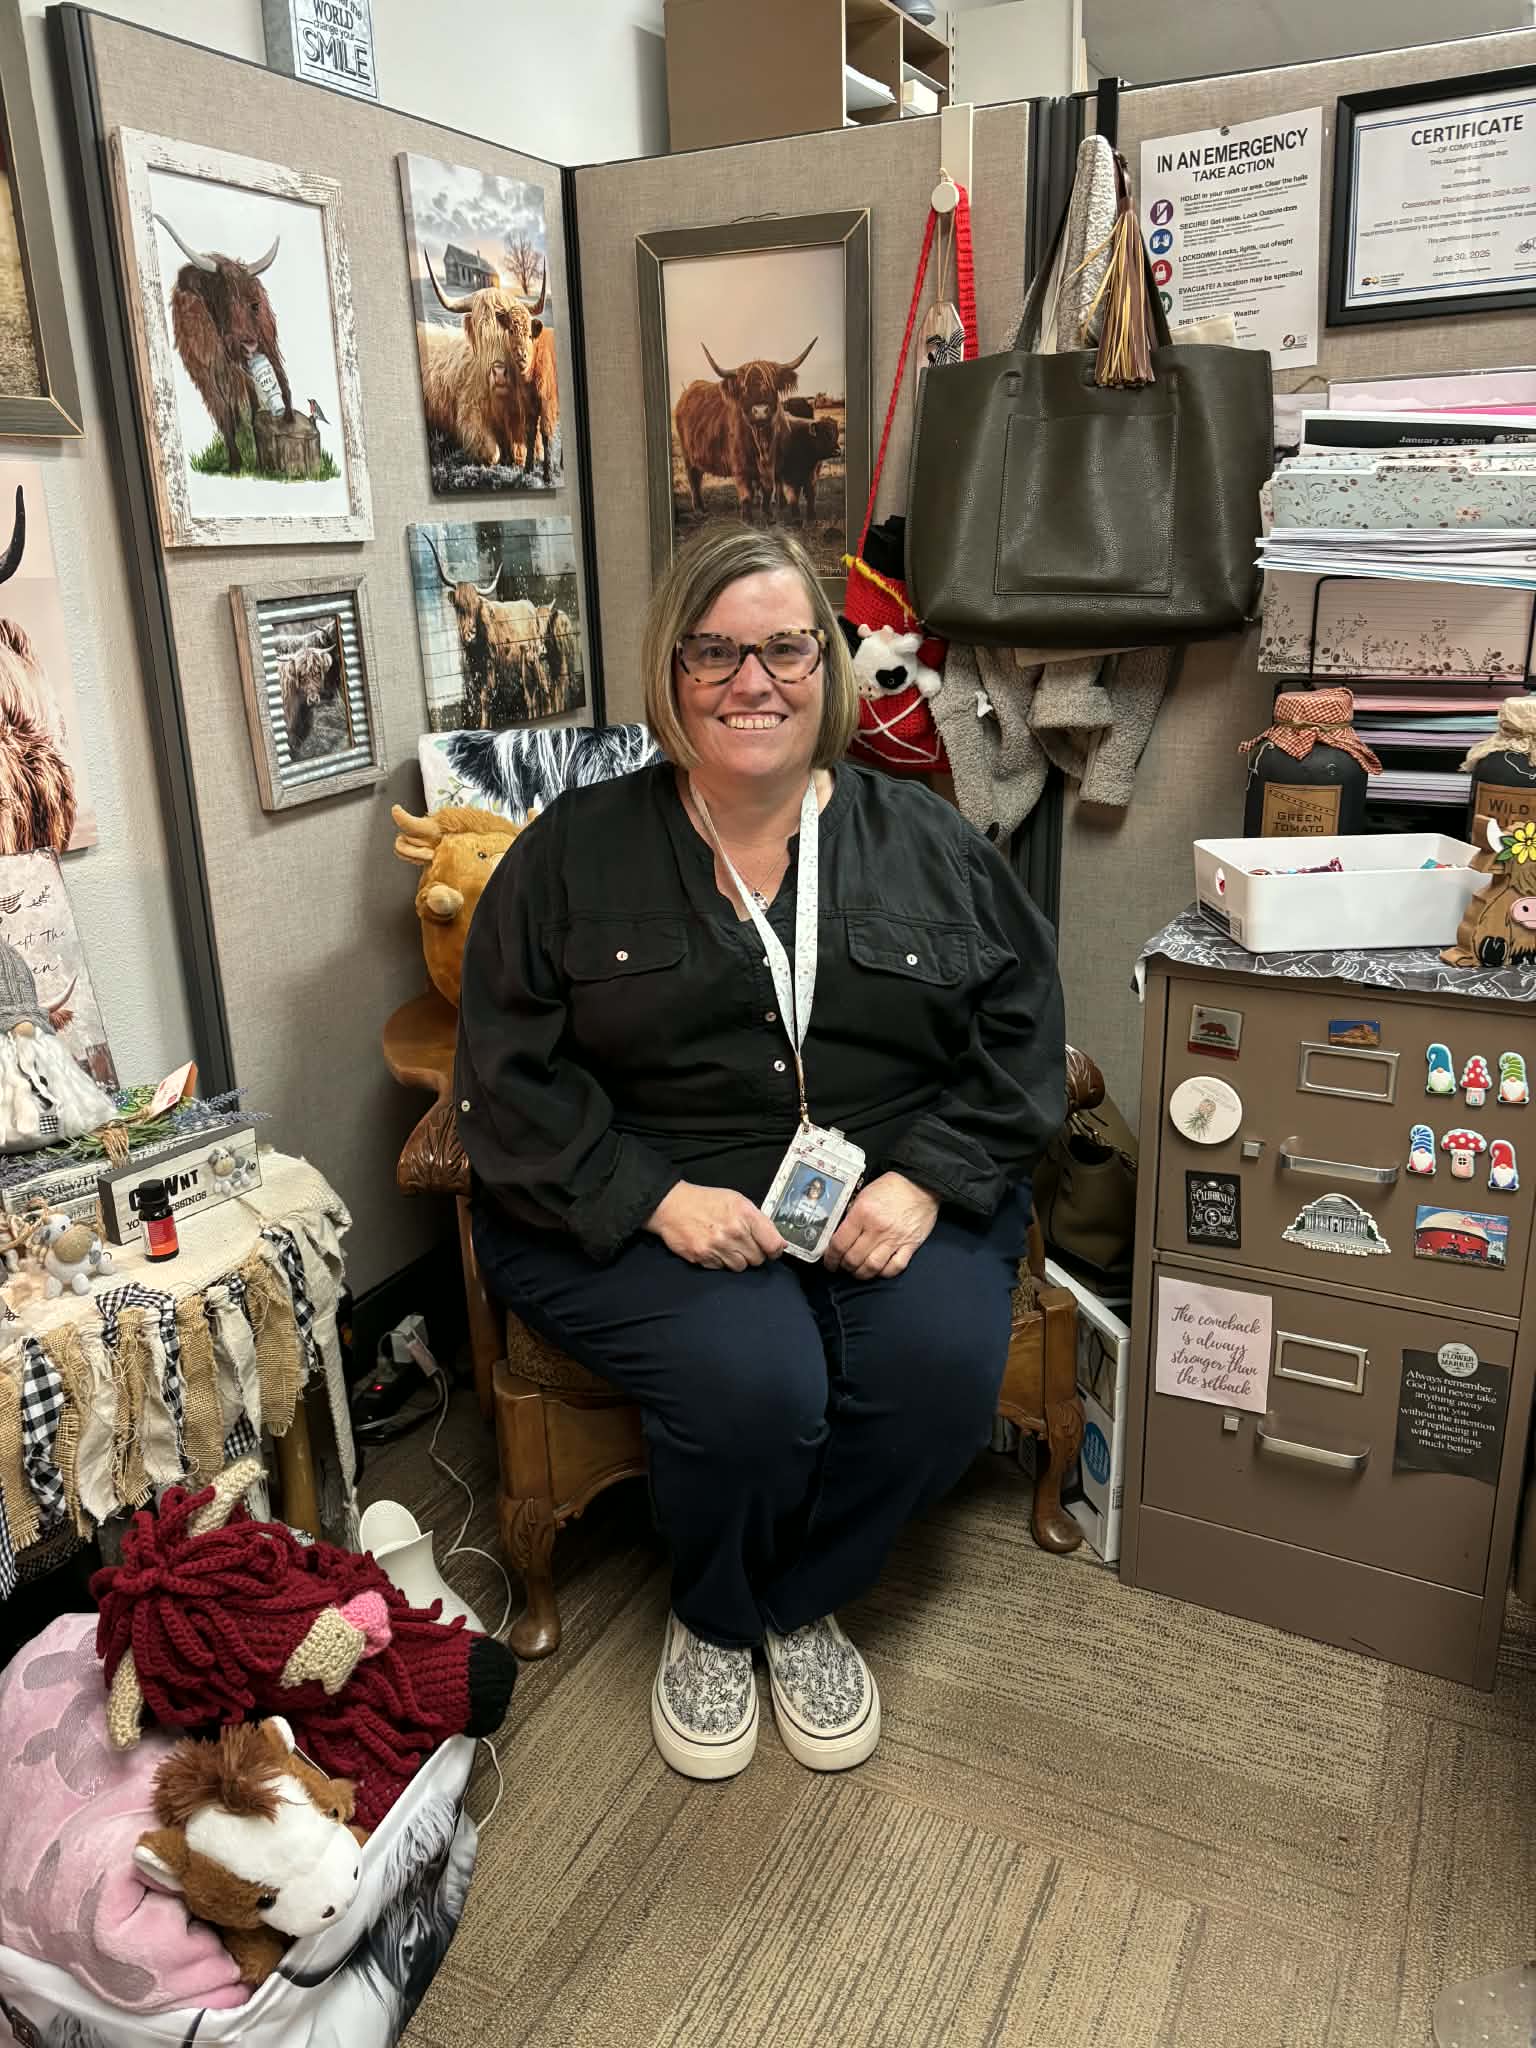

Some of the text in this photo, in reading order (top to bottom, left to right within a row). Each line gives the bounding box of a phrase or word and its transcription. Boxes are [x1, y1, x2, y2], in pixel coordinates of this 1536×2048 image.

[313, 0, 354, 30] WORLD
[313, 20, 355, 41] change your
[303, 27, 370, 80] SMILE
[1411, 114, 1524, 146] CERTIFICATE
[1156, 127, 1308, 173] IN AN EMERGENCY
[1438, 139, 1497, 154] OF COMPLETION
[1192, 157, 1275, 182] TAKE ACTION
[1209, 190, 1223, 200] your
[1264, 179, 1281, 188] Clear
[1282, 176, 1293, 185] the
[1210, 217, 1221, 225] Get
[1243, 211, 1258, 220] Lock
[1178, 250, 1218, 263] LOCKDOWN!
[1432, 254, 1453, 264] June
[1249, 276, 1263, 286] may
[1264, 273, 1273, 282] be
[1399, 436, 1440, 445] January
[1488, 798, 1529, 815] WILD
[1277, 811, 1322, 822] GREEN
[1272, 822, 1324, 833] TOMATO
[39, 927, 66, 945] The
[129, 1169, 199, 1212] CWNT
[1196, 1189, 1231, 1206] CALIFORNIA
[1171, 1303, 1261, 1335] The comeback
[1182, 1331, 1248, 1359] is always
[1170, 1348, 1259, 1376] stronger than
[1441, 1359, 1474, 1369] MARKET
[1442, 1352, 1474, 1362] FLOWER
[1176, 1365, 1253, 1396] the setback
[1406, 1369, 1442, 1383] Always
[1405, 1379, 1497, 1404] God will never take
[1415, 1390, 1483, 1412] anything away
[1427, 1402, 1470, 1417] from you
[1400, 1407, 1496, 1432] without the intention
[1414, 1419, 1479, 1438] of replacing it
[1411, 1427, 1482, 1449] with something
[1418, 1439, 1445, 1449] much
